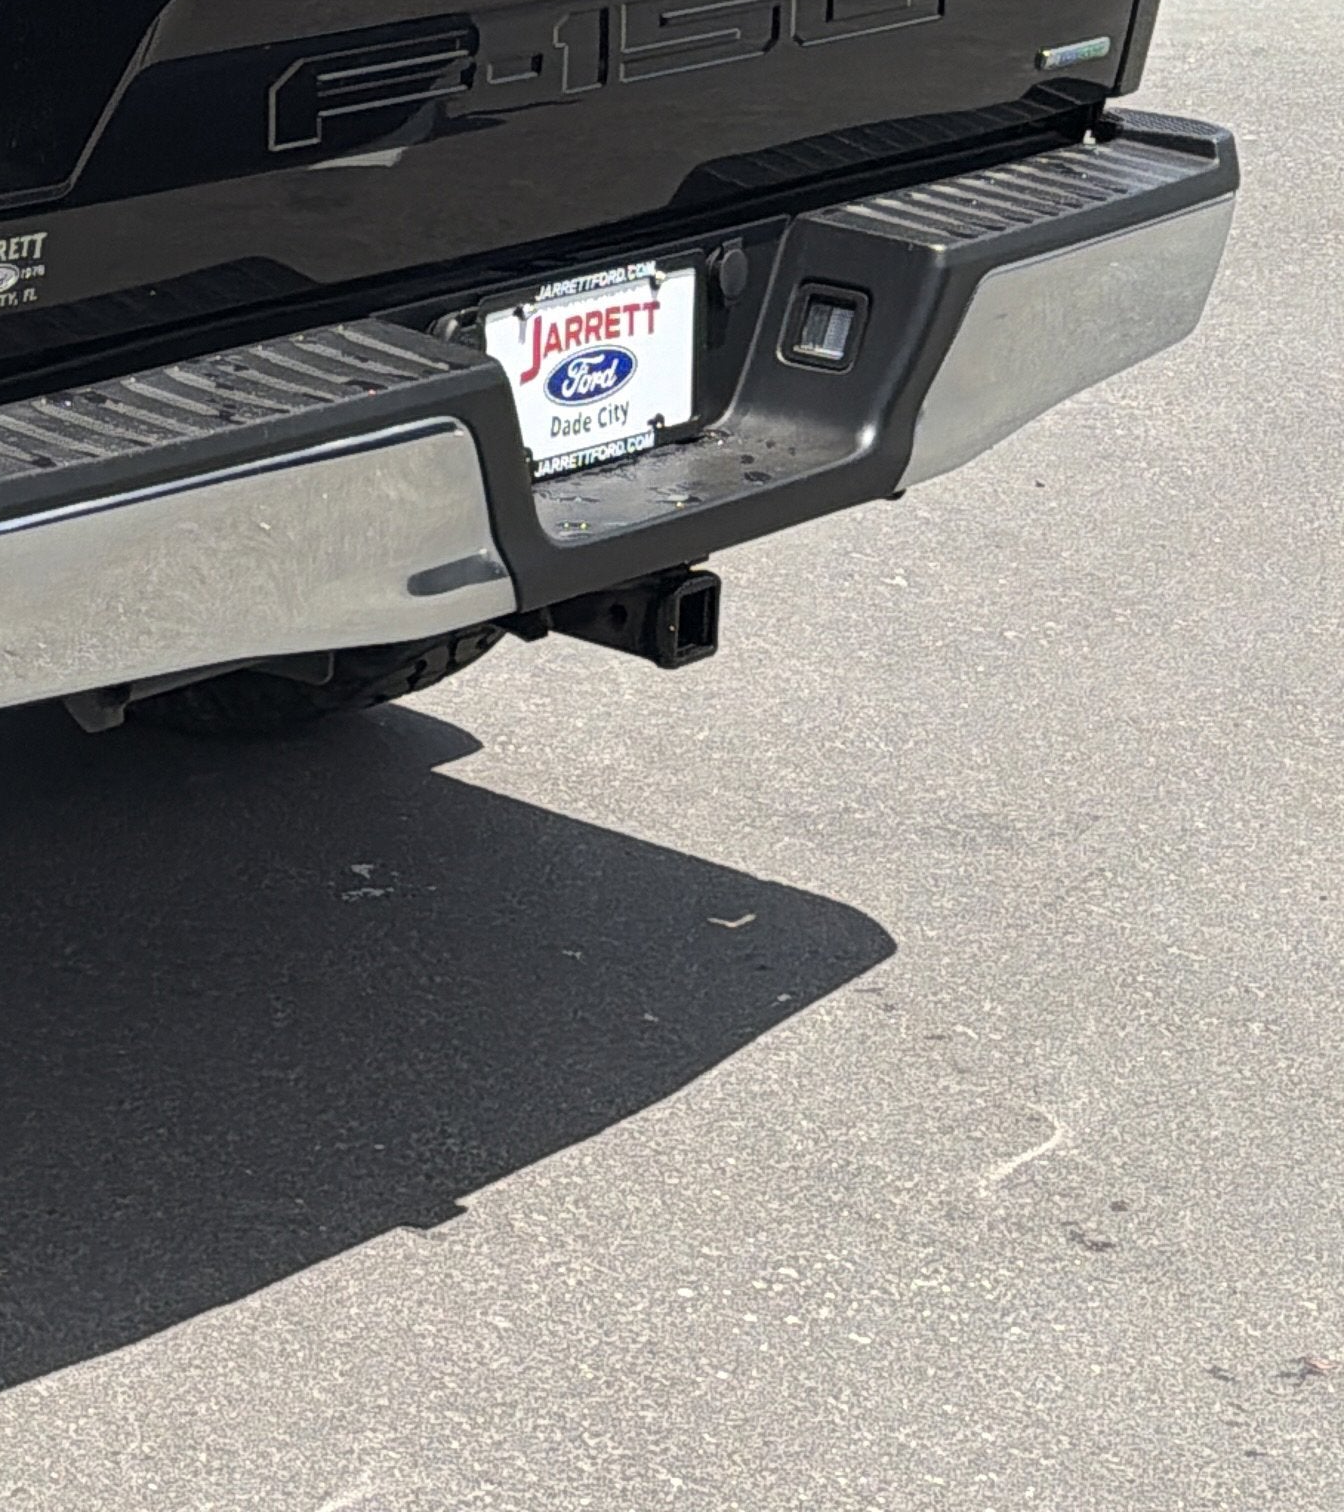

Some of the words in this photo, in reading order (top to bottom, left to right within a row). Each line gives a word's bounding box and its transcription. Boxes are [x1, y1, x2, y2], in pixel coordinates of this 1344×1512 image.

[21, 287, 38, 303] FL
[519, 299, 661, 387] JARRETT
[562, 352, 620, 398] Ford
[550, 411, 593, 438] Dade
[597, 400, 630, 428] City
[533, 430, 656, 478] JARRETTFORD.COM
